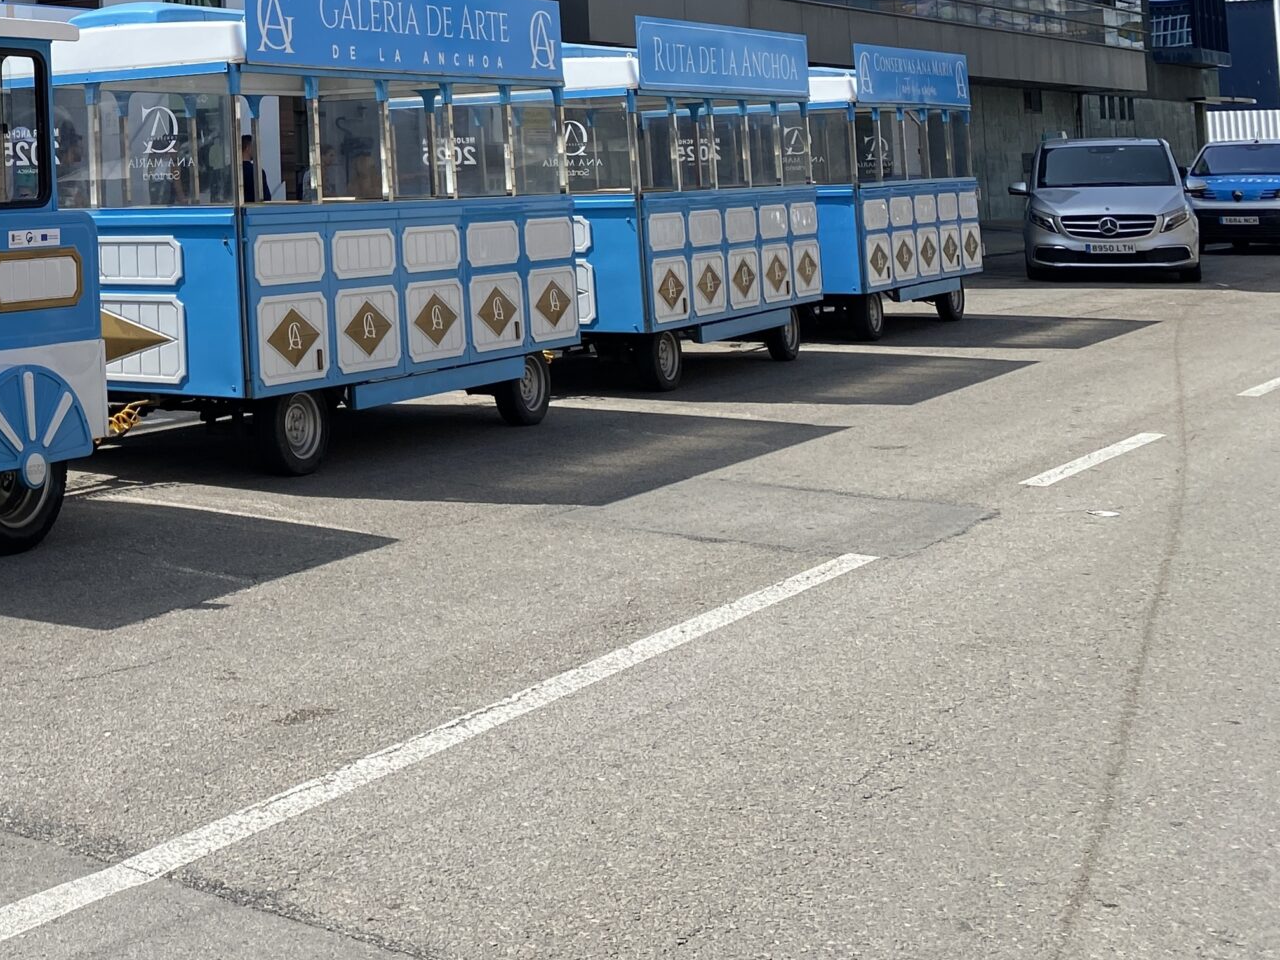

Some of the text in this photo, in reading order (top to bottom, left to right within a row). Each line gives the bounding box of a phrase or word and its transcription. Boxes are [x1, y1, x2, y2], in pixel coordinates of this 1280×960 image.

[425, 5, 454, 38] DE
[460, 4, 510, 43] ARTE
[332, 44, 504, 70] DE LA ANCHOA
[653, 37, 799, 81] RUTA DE LA ANCHOA
[873, 53, 916, 74] CONSERVAS
[1092, 244, 1134, 252] 8950 LTH
